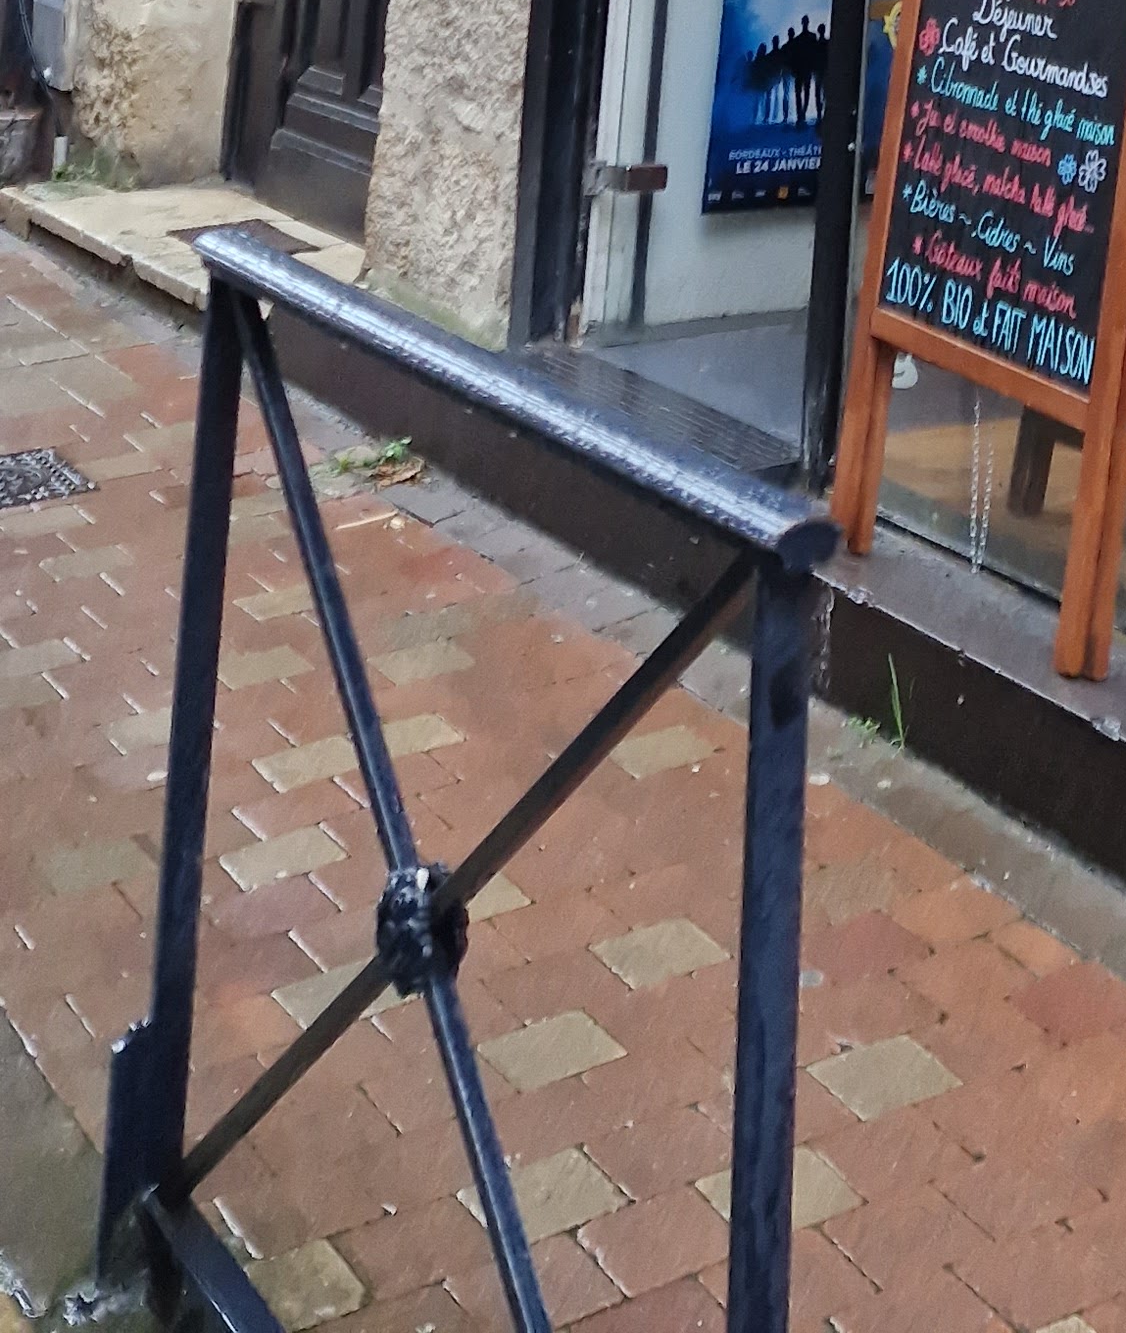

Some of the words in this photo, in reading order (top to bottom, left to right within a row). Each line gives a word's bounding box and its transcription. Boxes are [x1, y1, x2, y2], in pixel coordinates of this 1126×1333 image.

[938, 17, 980, 72] Café
[981, 36, 995, 66] et
[1005, 89, 1019, 117] et
[735, 160, 751, 175] LE
[753, 159, 769, 173] 24
[909, 179, 957, 224] Bières
[972, 208, 1021, 254] Cidres
[1042, 235, 1076, 276] Vins
[885, 256, 937, 313] 100%
[941, 278, 973, 330] BIO
[973, 299, 989, 337] et
[991, 300, 1027, 354] FAIT
[1026, 311, 1096, 386] MAISON
[1023, 280, 1077, 320] maison
